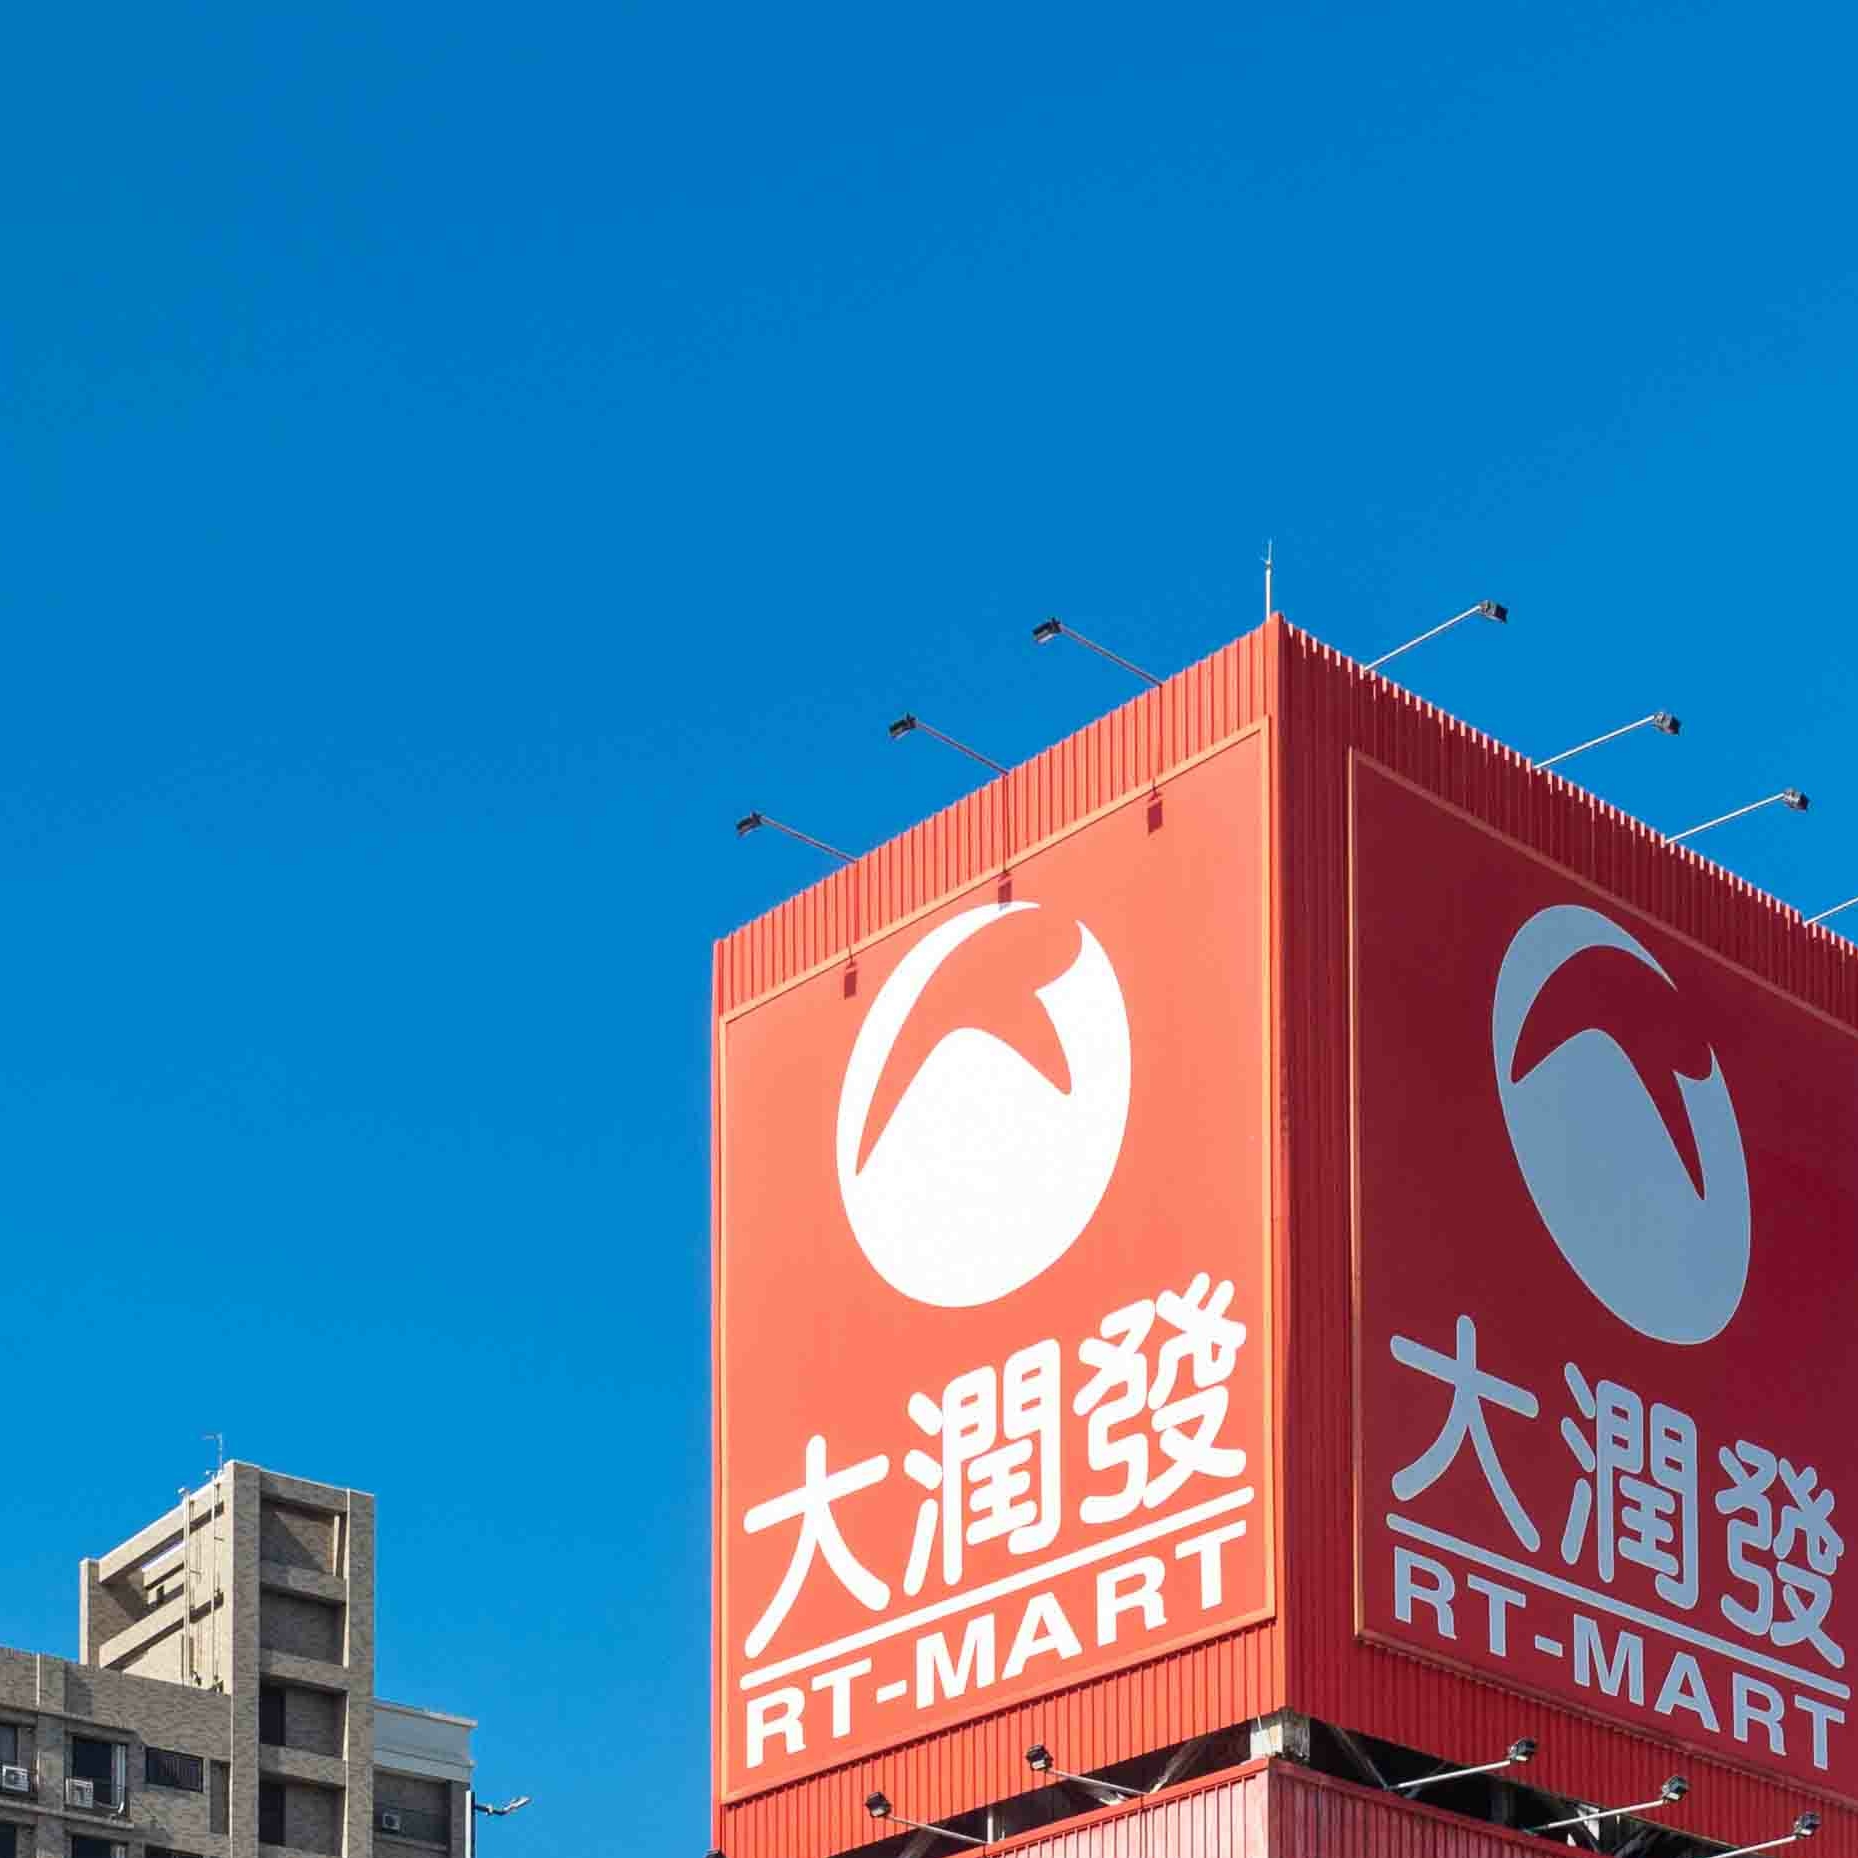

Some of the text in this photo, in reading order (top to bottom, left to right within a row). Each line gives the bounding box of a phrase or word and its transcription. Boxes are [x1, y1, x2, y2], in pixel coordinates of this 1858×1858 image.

[744, 1273, 1246, 1658] 大潤發
[1390, 1315, 1845, 1667] 大潤發
[745, 1520, 1247, 1769] RT-MART
[1393, 1545, 1846, 1772] RT-MART
